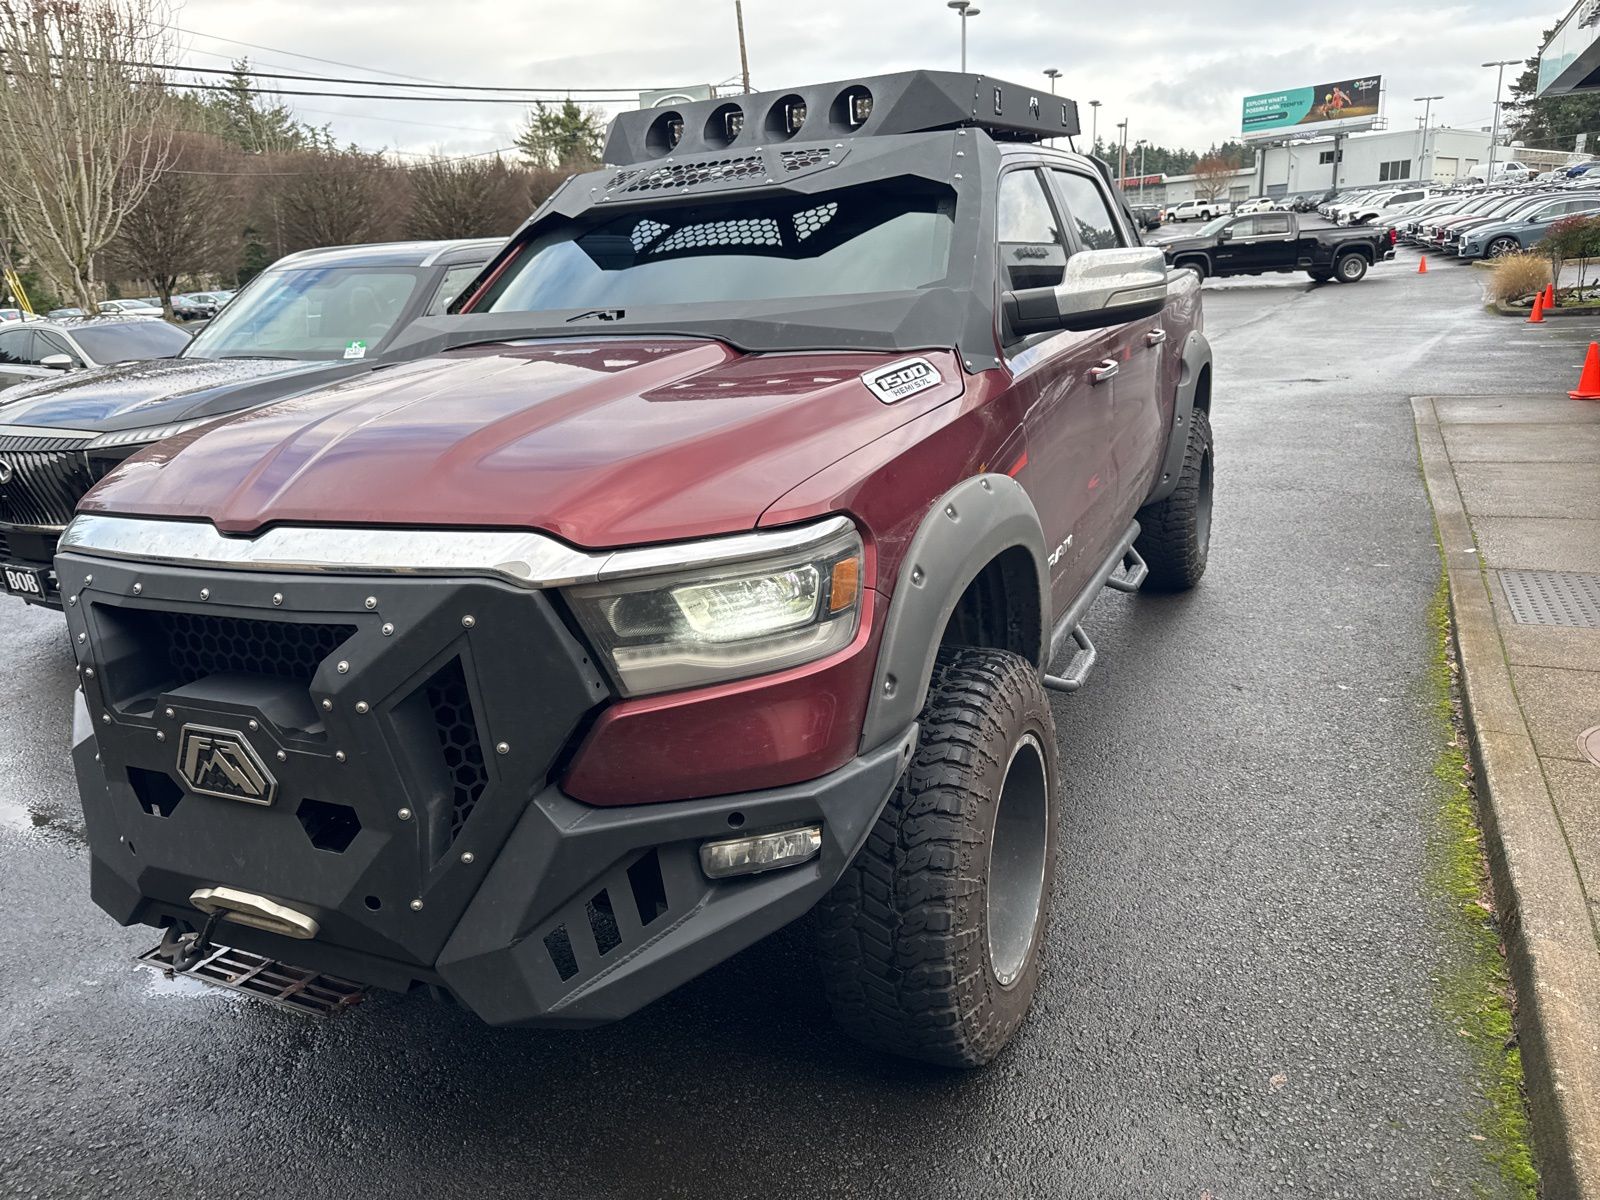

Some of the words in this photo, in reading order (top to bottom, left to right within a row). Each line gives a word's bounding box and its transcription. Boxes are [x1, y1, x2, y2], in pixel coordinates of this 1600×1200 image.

[1246, 99, 1267, 108] EXPLORE
[1268, 96, 1287, 104] WHAT'S
[876, 363, 927, 391] 1500
[892, 384, 914, 397] HEMI
[5, 570, 39, 593] BOB
